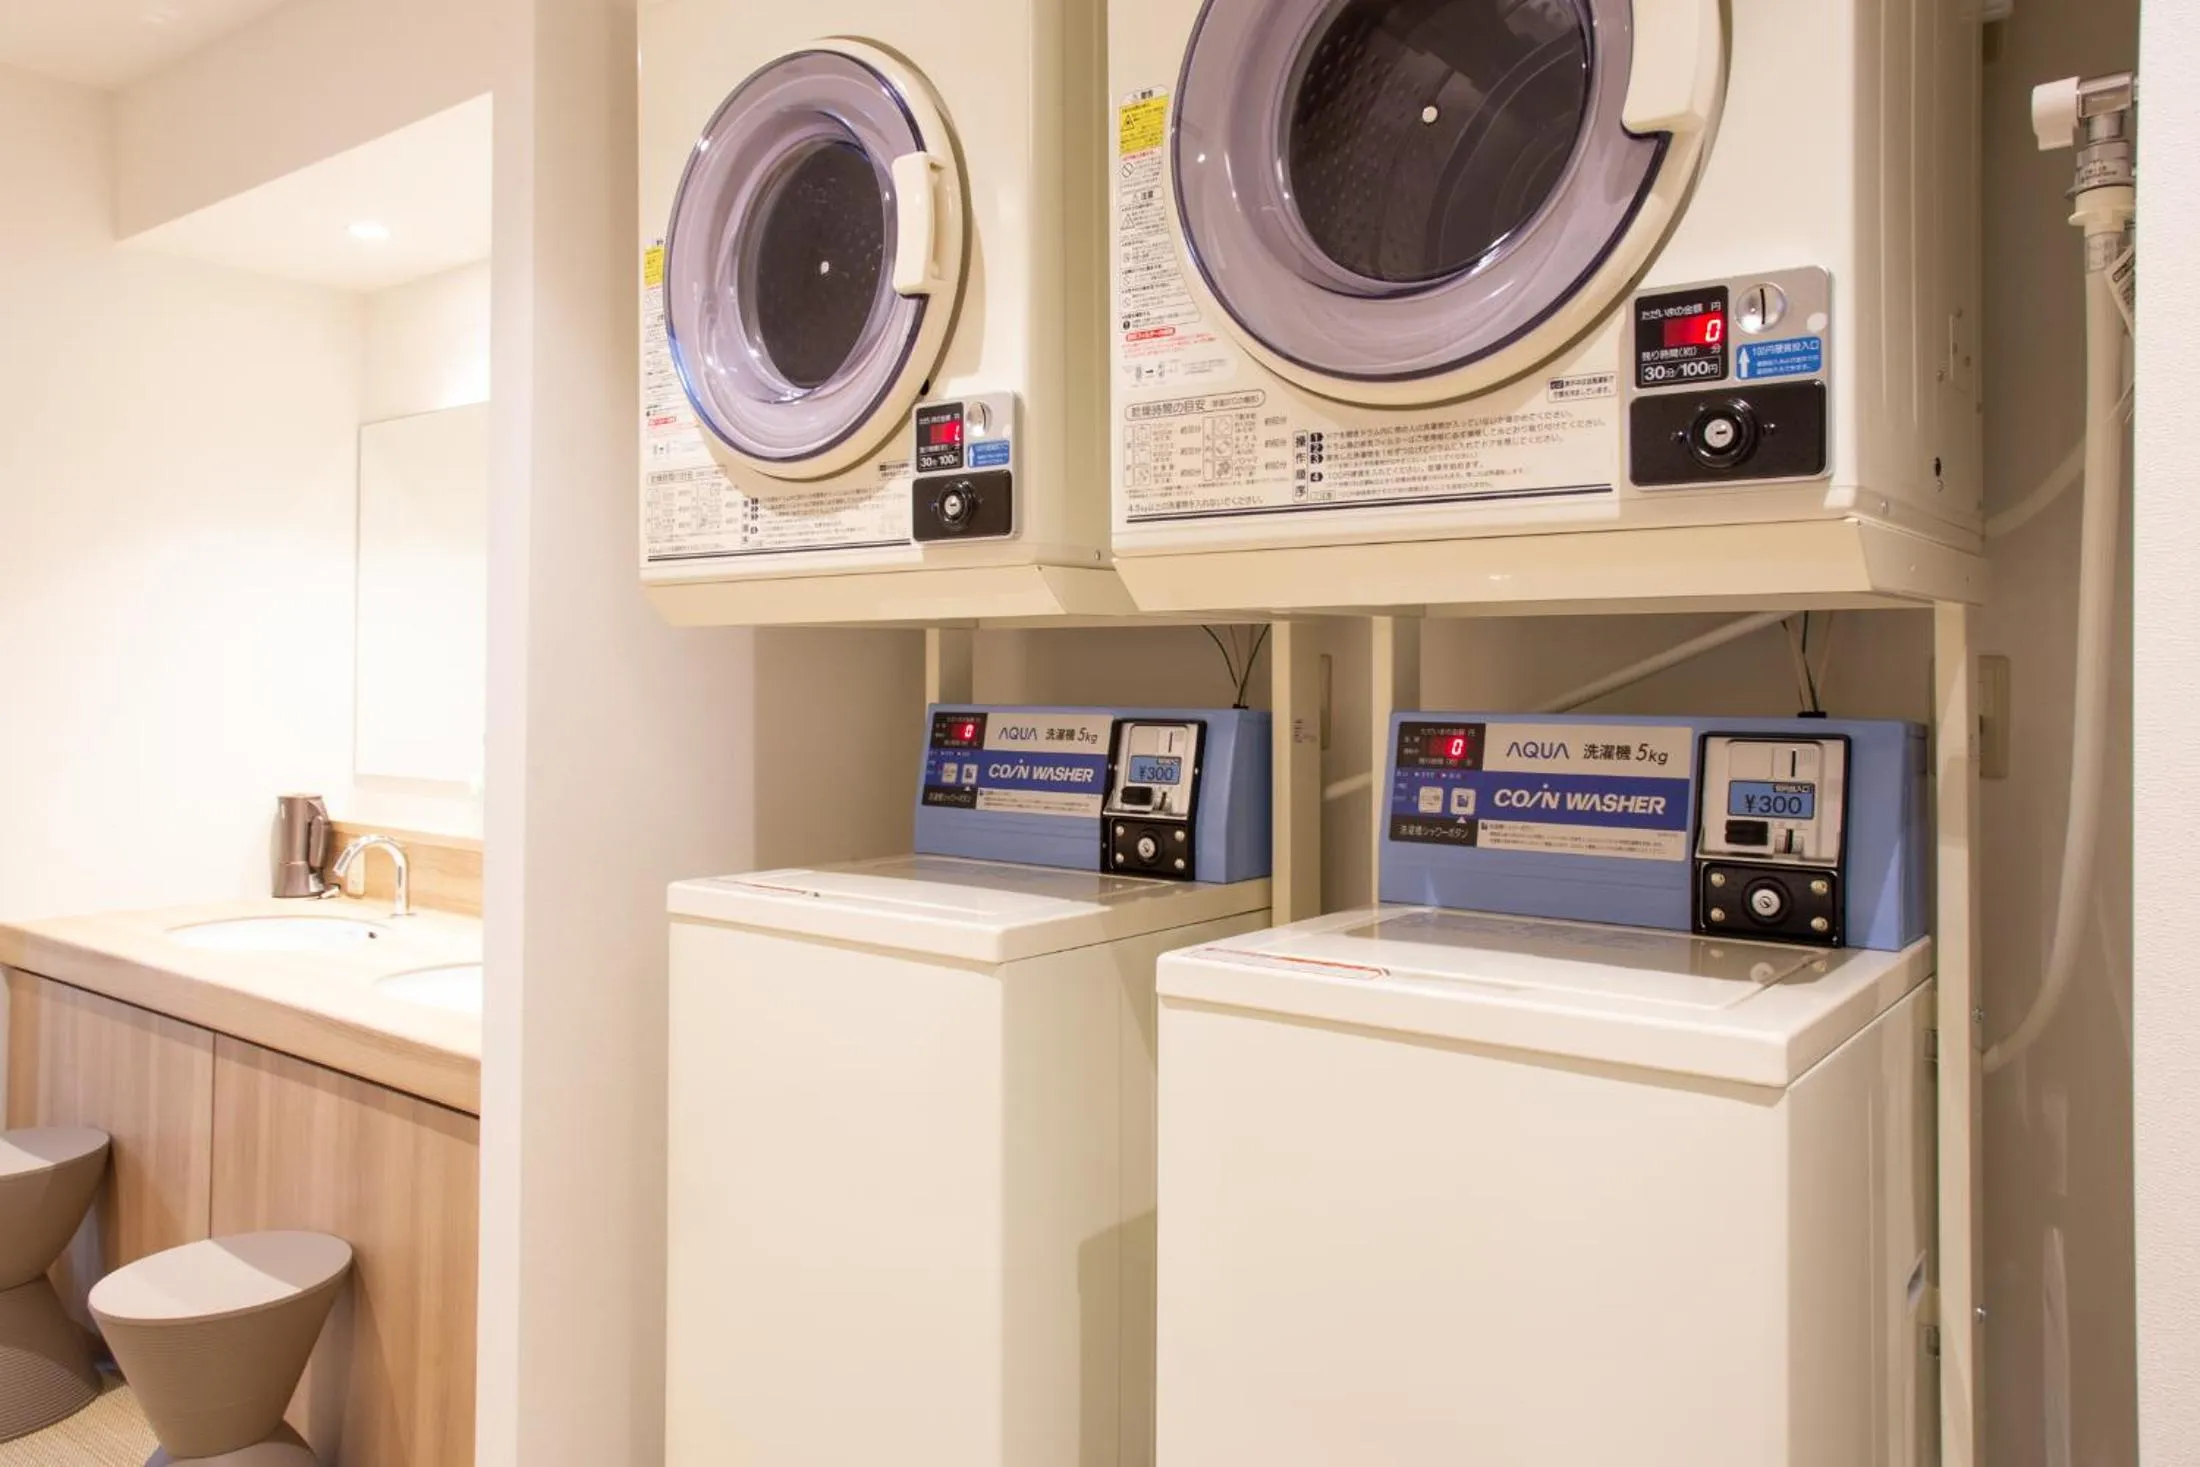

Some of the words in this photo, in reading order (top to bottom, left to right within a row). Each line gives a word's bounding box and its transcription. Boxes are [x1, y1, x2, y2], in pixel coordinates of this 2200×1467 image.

[1710, 301, 1721, 312] 円
[1705, 319, 1721, 342] 0
[1131, 400, 1206, 418] 乾燥時間の目安
[998, 727, 1038, 741] AQUA
[1044, 728, 1076, 742] 洗濯機
[1077, 727, 1098, 744] 5kg
[1451, 738, 1464, 756] 0
[1506, 741, 1570, 761] AQUA
[1583, 743, 1631, 762] 洗濯機
[1635, 742, 1669, 765] 5kg
[988, 760, 1030, 782] COIN
[1032, 765, 1094, 783] WASHER
[1138, 766, 1173, 782] ¥300
[1494, 782, 1561, 811] COIN
[1566, 793, 1666, 816] WASHER
[1744, 793, 1802, 815] ¥300
